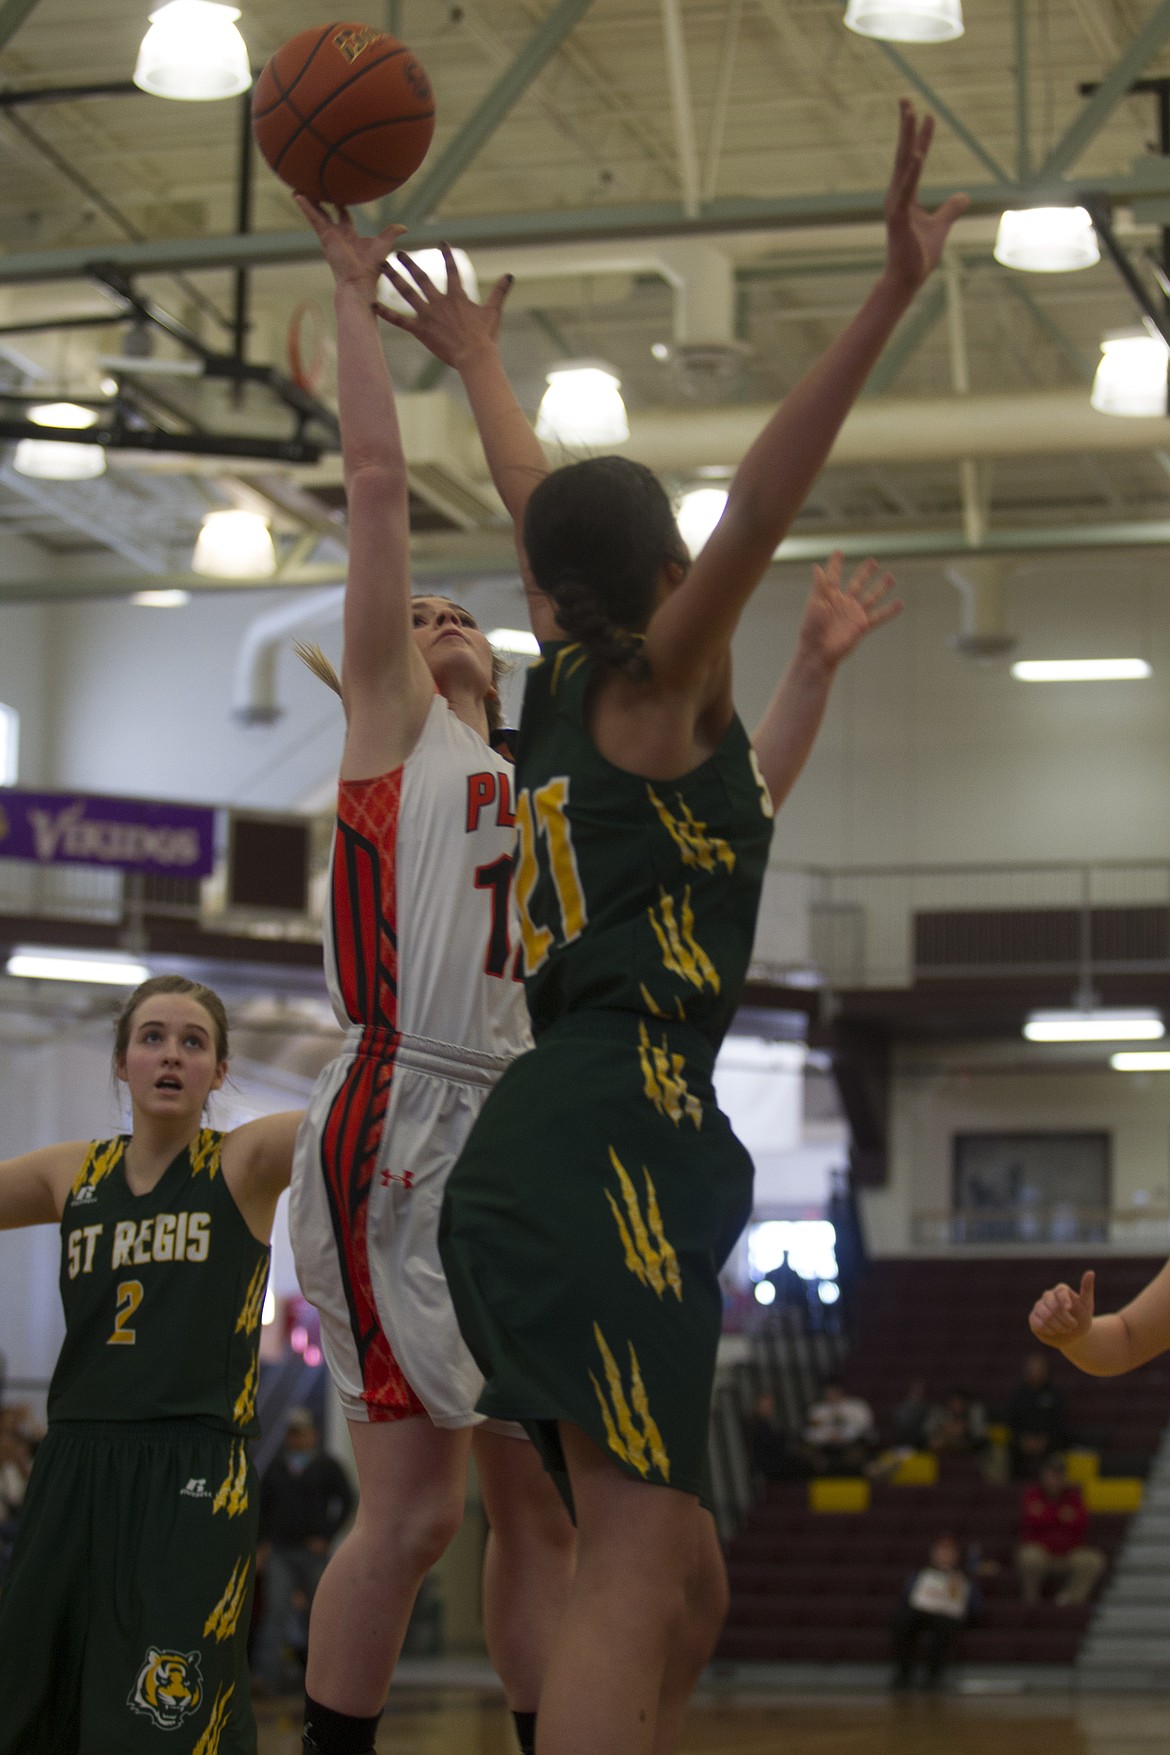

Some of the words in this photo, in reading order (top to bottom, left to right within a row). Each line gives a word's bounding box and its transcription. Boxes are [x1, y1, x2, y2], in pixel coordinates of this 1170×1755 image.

[68, 1223, 103, 1280] ST
[111, 1211, 211, 1271] REGIS
[106, 1279, 144, 1345] 2
